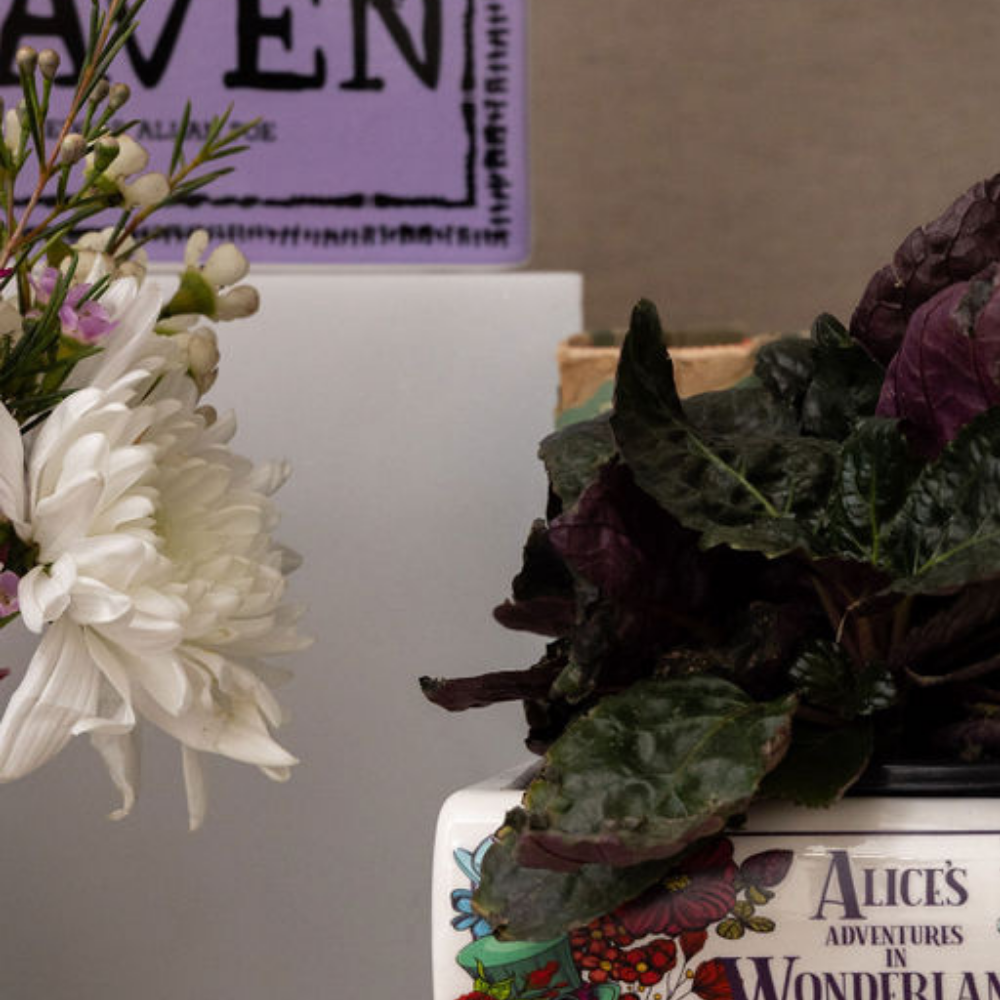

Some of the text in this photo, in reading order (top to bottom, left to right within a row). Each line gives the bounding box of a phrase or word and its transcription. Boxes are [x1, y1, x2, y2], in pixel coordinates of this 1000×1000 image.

[809, 849, 969, 921] ALICE'S
[825, 925, 964, 947] ADVENTURES
[885, 947, 907, 968] IN
